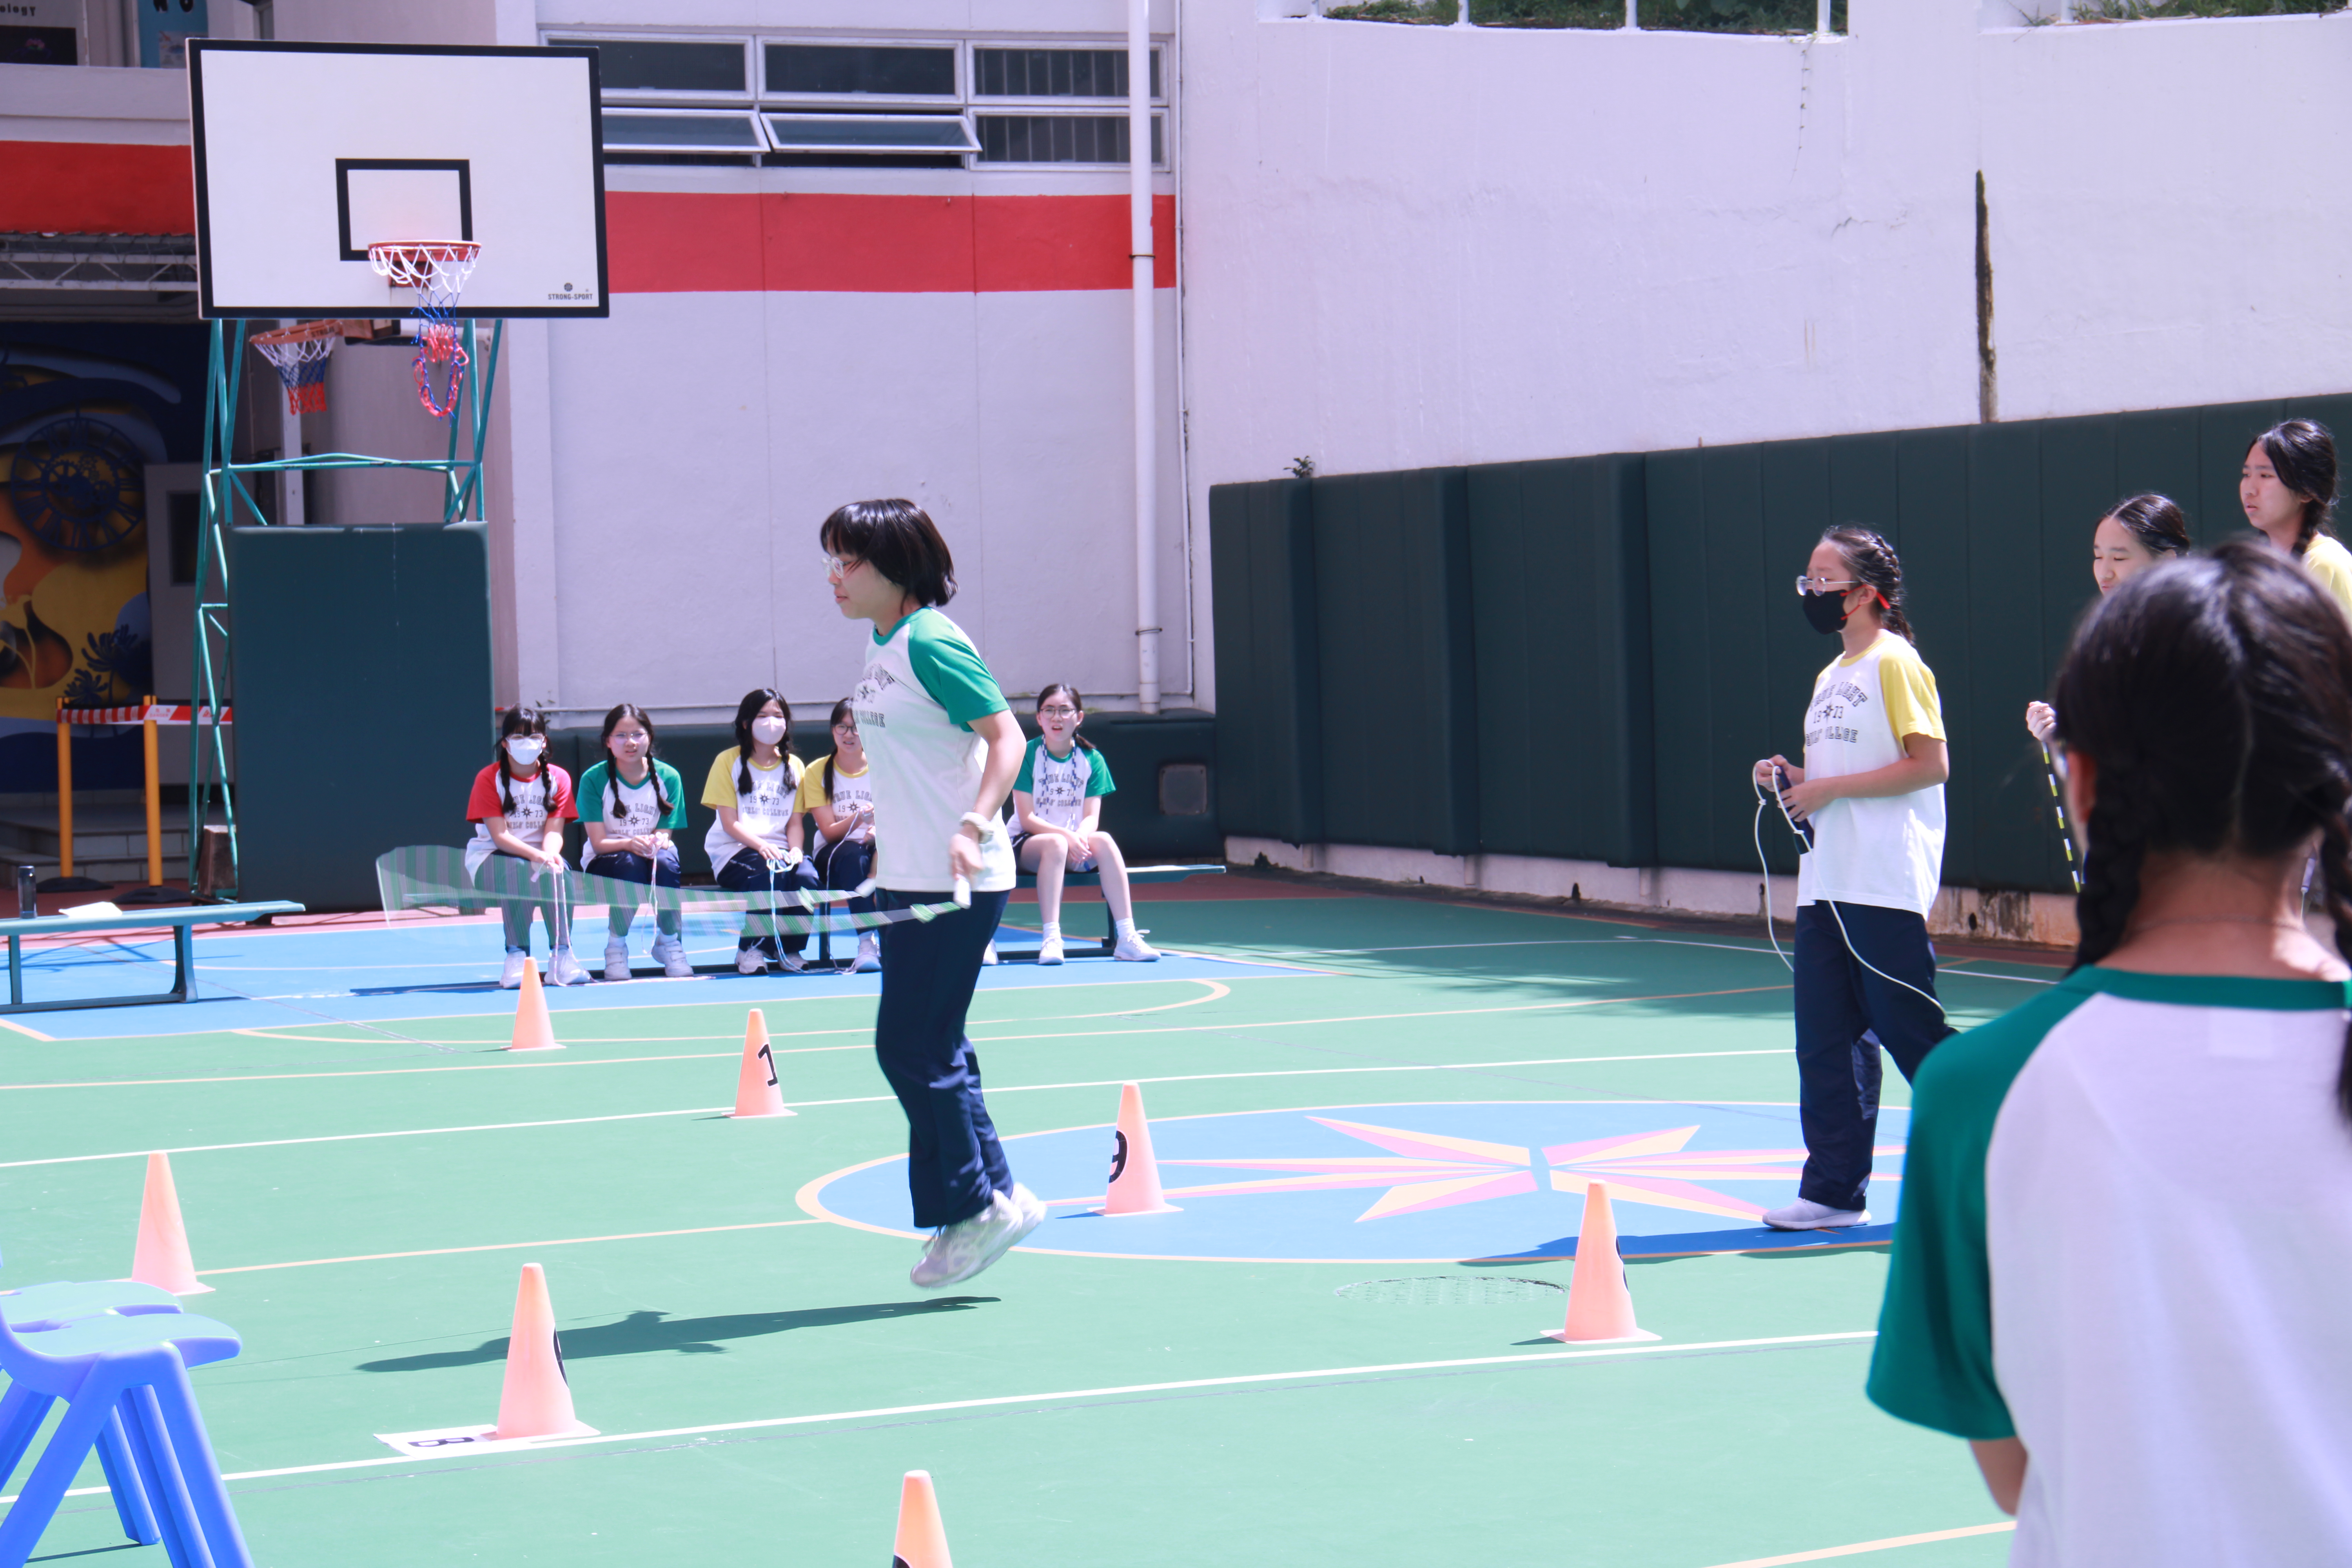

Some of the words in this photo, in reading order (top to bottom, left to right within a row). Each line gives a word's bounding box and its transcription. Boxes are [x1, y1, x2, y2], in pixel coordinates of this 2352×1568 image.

[1833, 706, 1844, 719] 73
[535, 809, 543, 818] 73
[758, 1044, 778, 1087] 1
